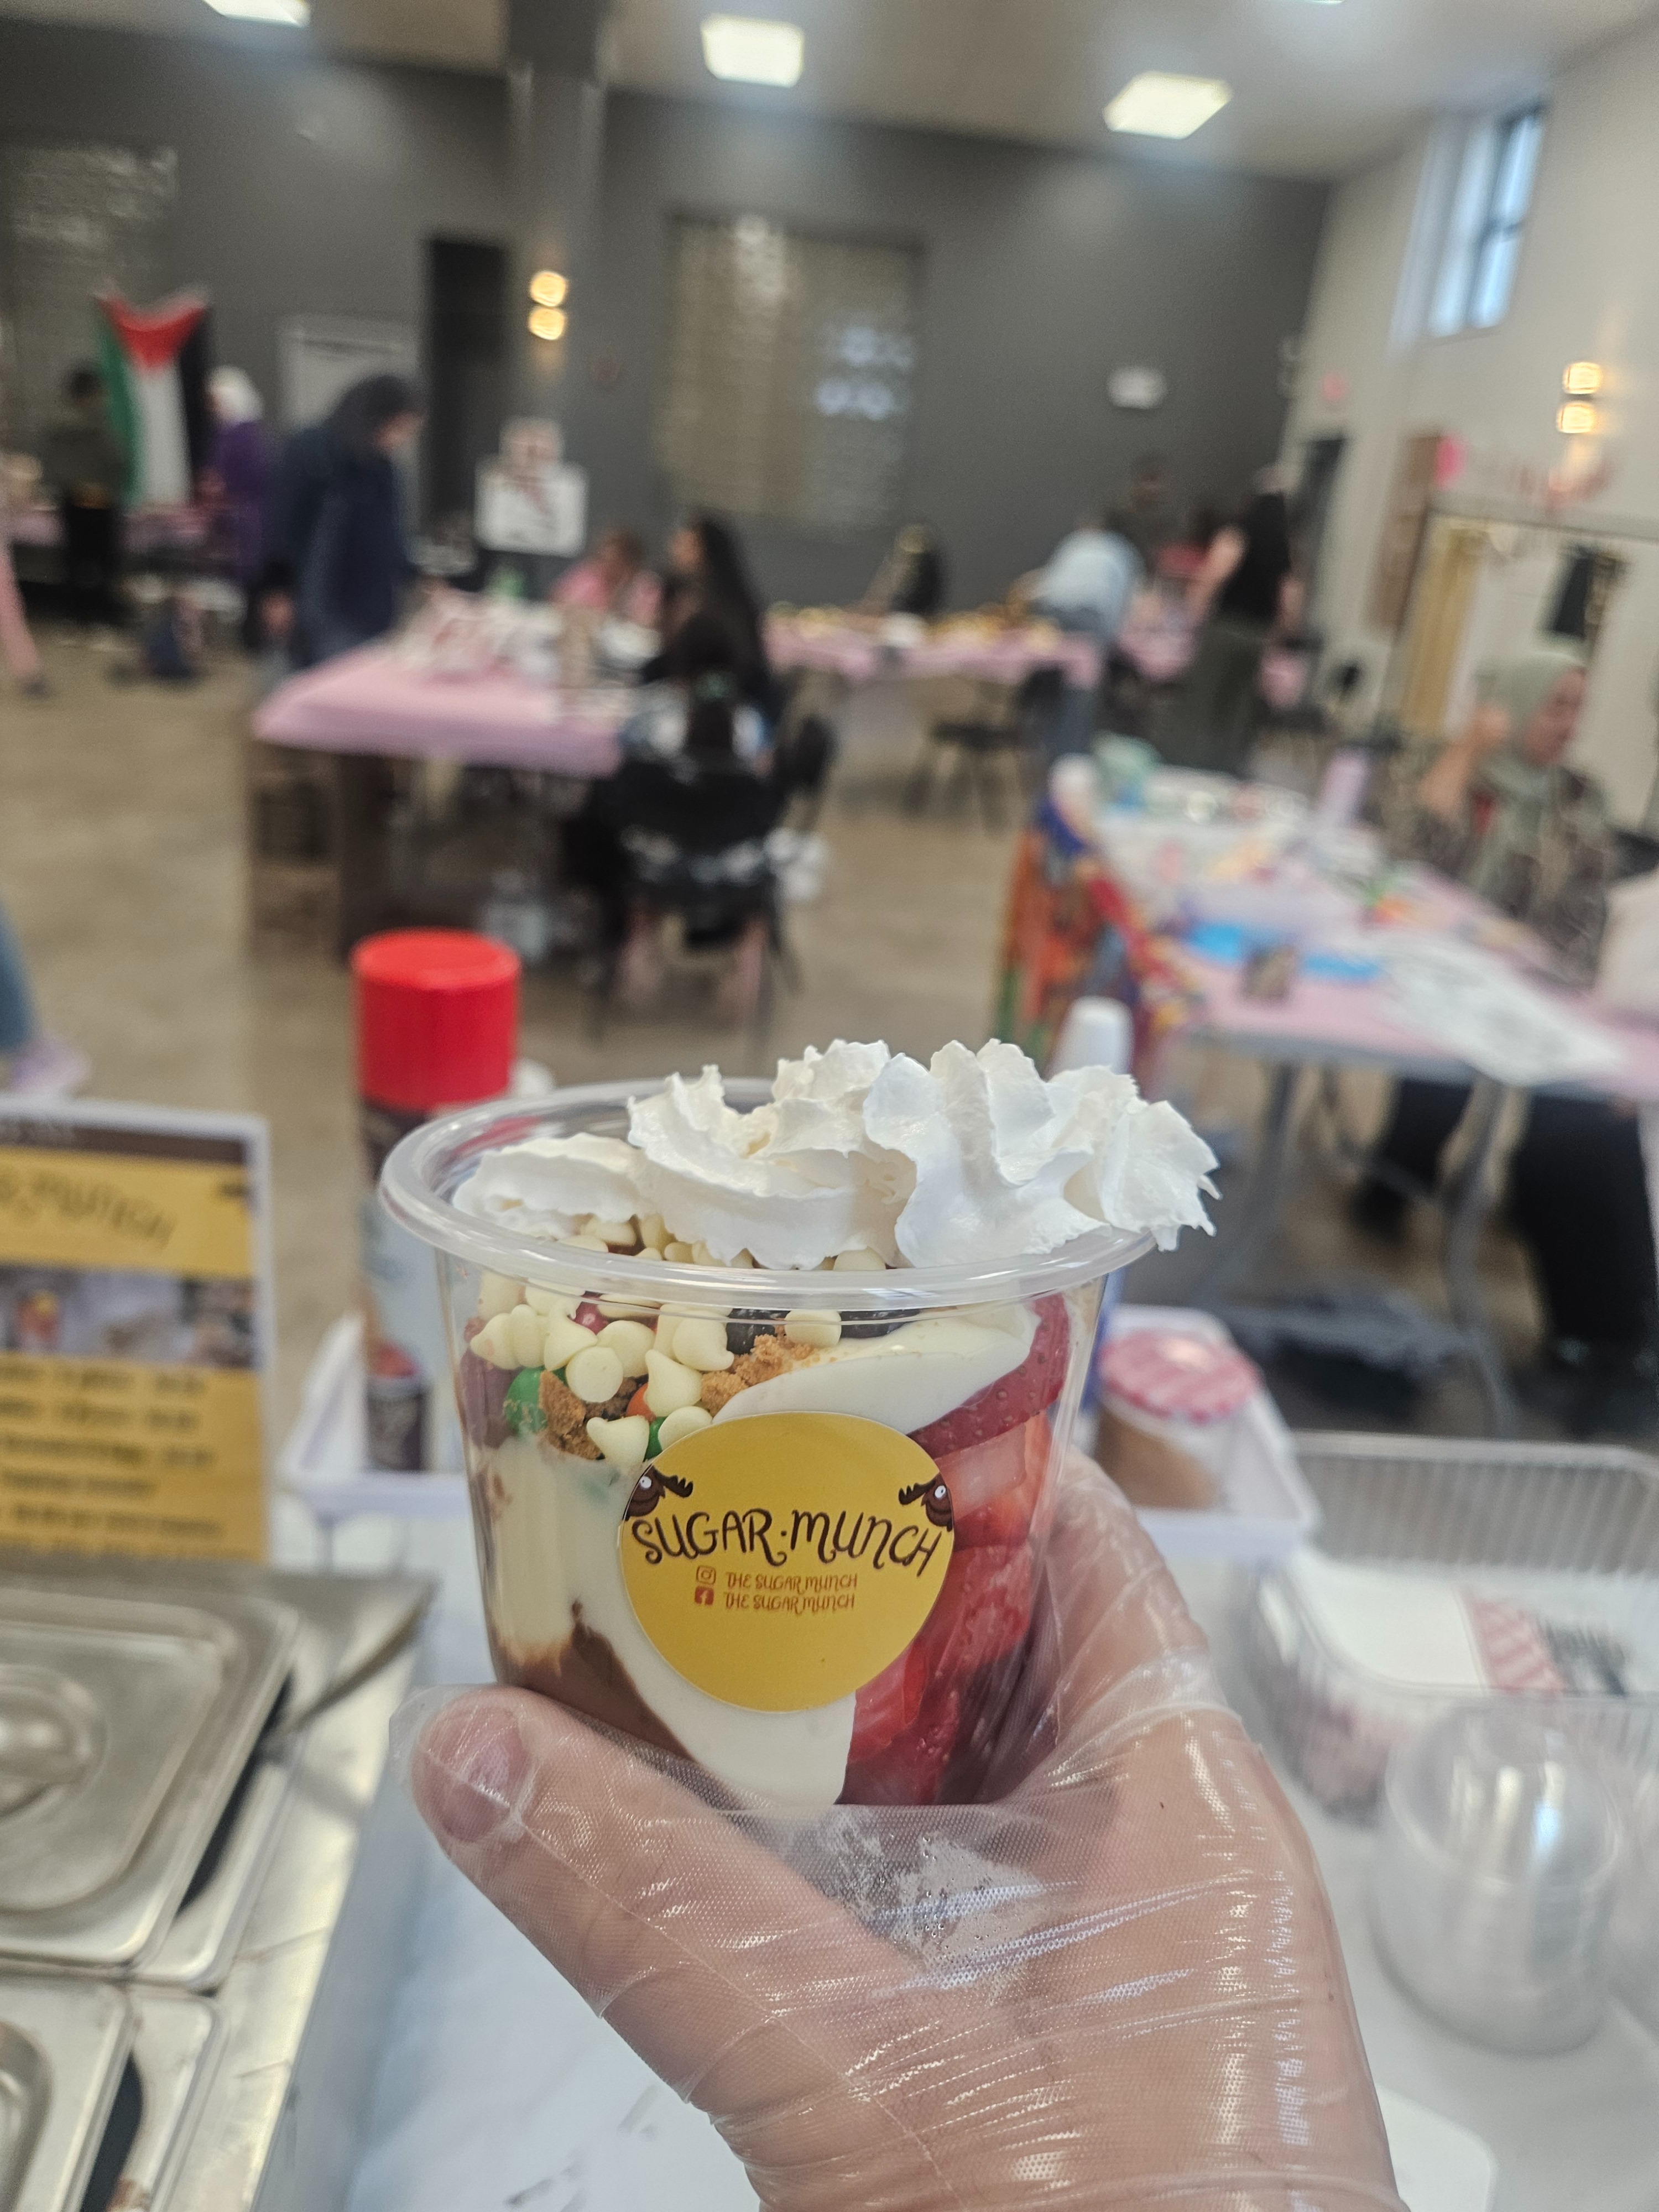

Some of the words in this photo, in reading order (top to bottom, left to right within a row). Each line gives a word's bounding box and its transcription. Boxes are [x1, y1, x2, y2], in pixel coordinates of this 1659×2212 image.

[726, 1571, 751, 1589] THE
[755, 1573, 805, 1595] SUGAR
[724, 1592, 750, 1610] THE
[753, 1593, 803, 1616] SUGAR
